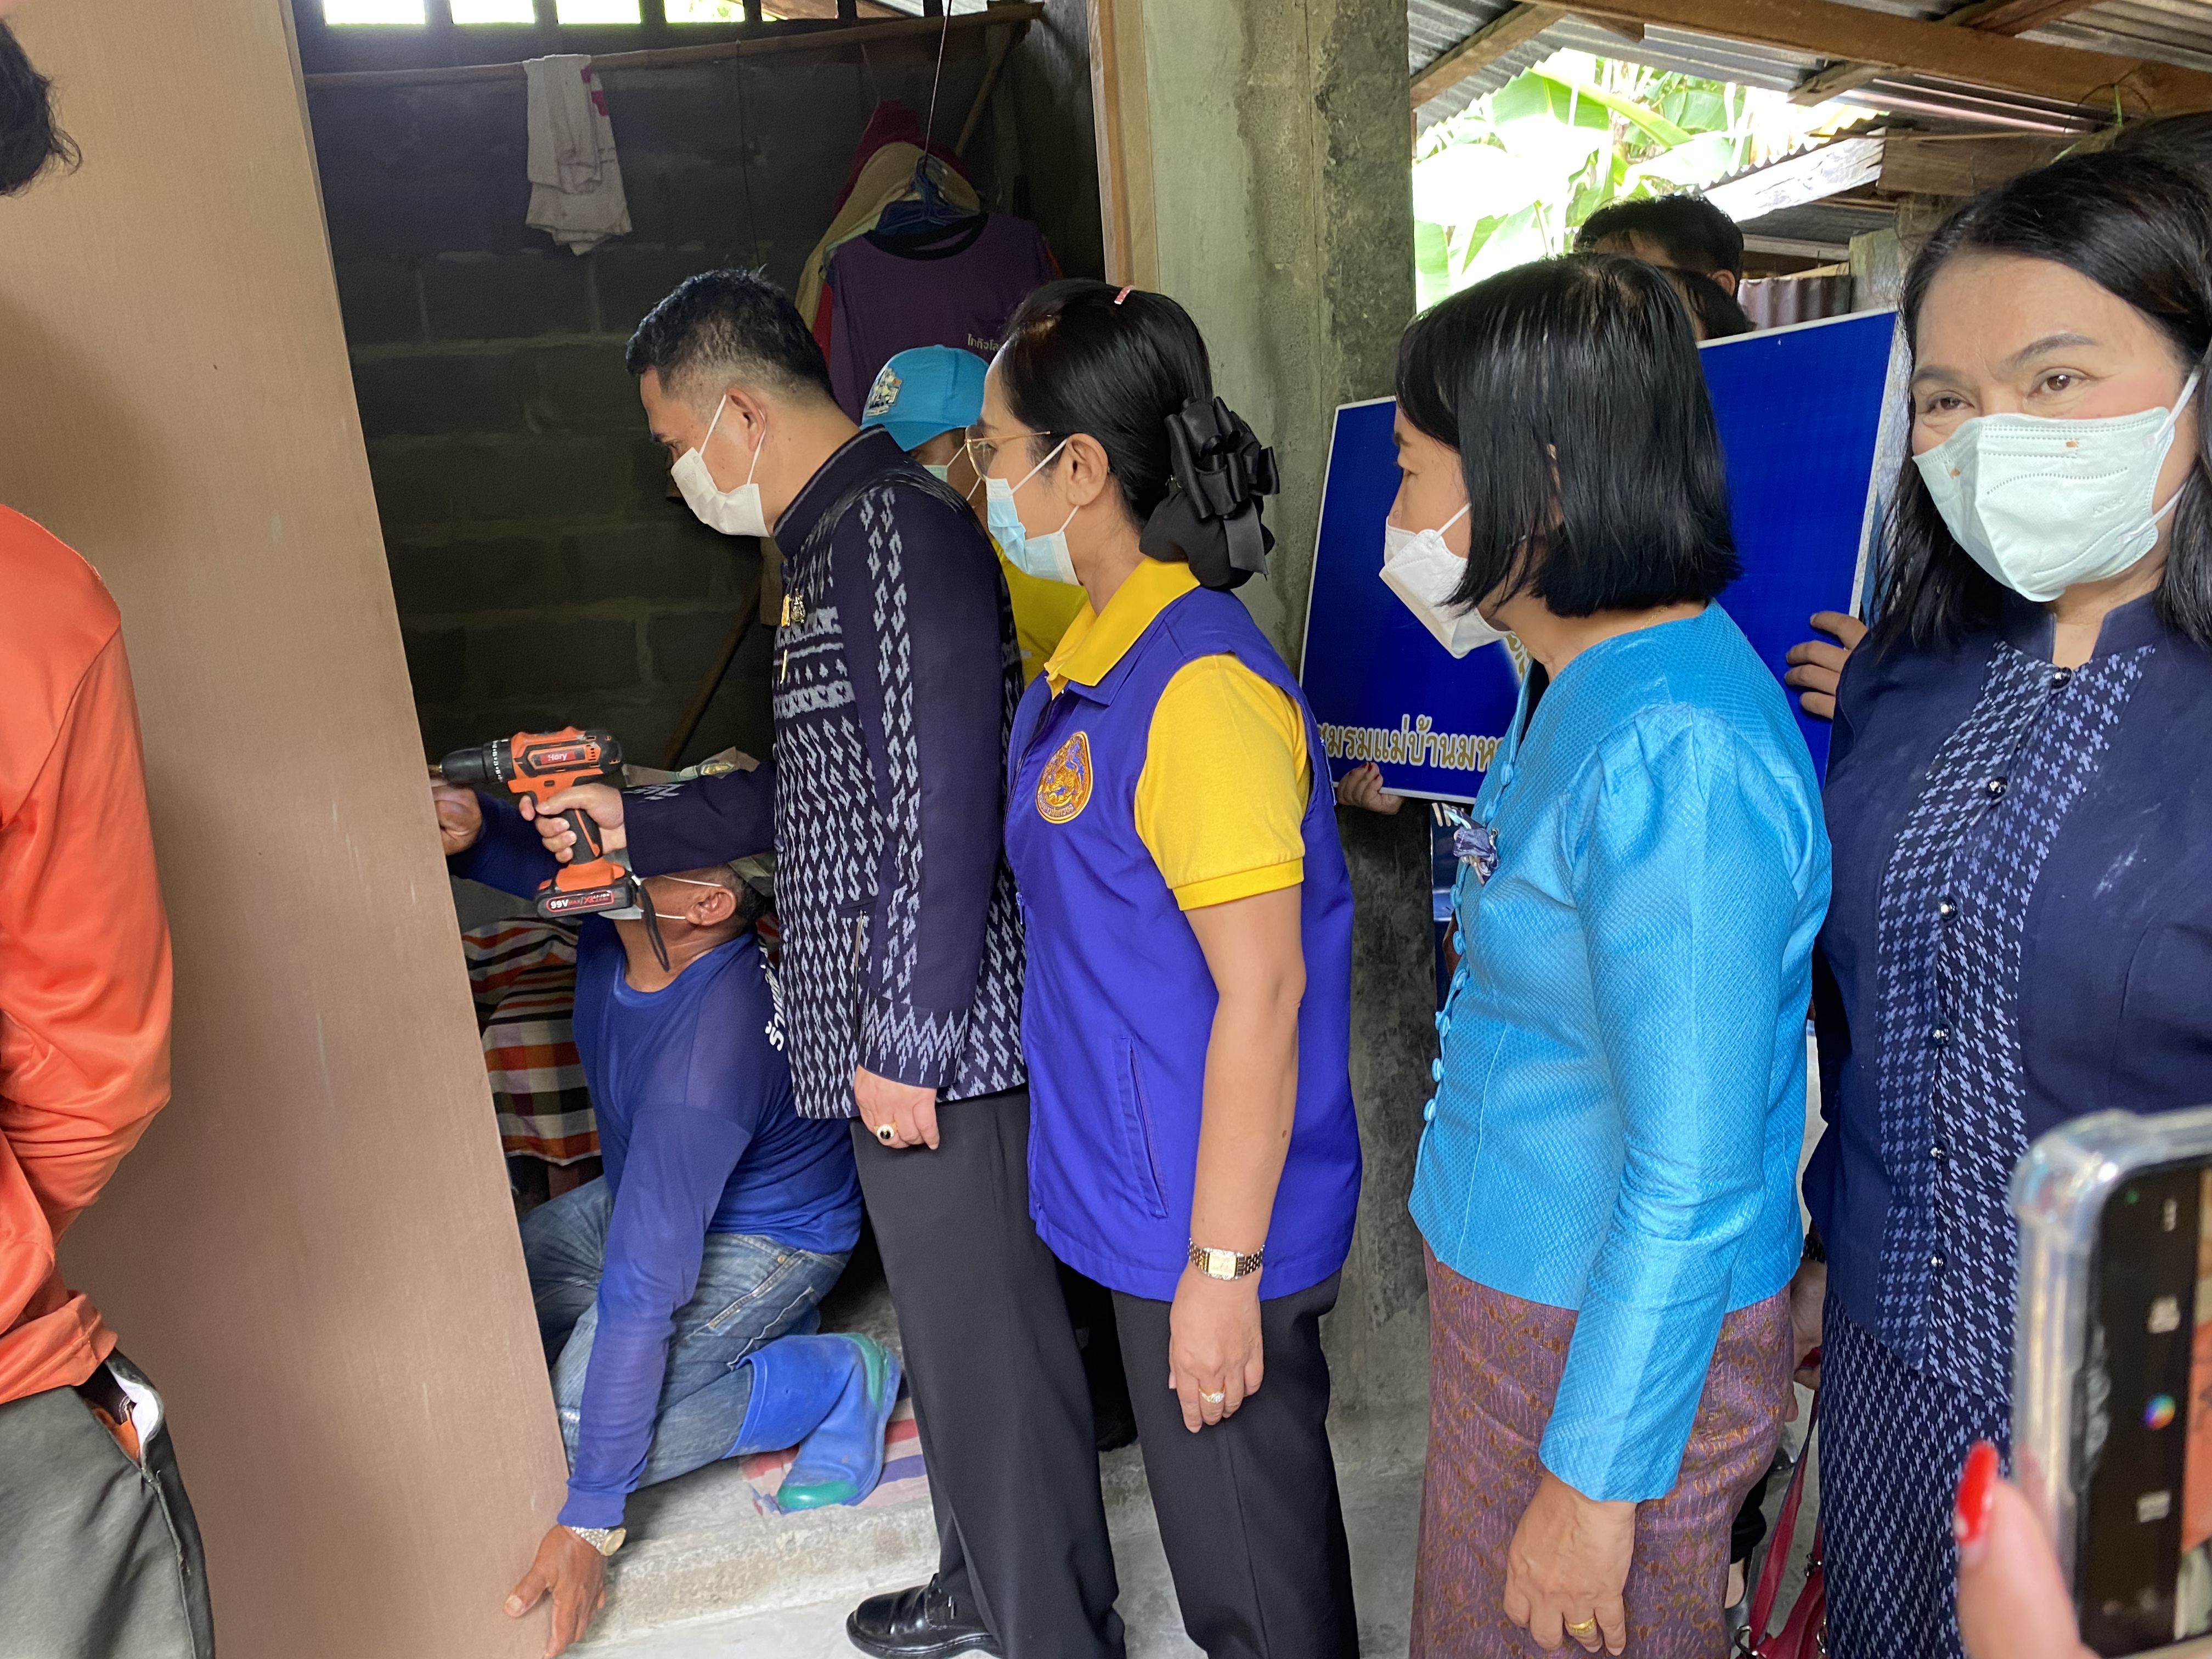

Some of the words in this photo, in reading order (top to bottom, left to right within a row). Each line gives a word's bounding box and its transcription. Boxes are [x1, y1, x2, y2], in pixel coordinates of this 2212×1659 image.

[1317, 714, 1503, 772] มรมแม่บ้านมห
[550, 899, 569, 909] 99V
